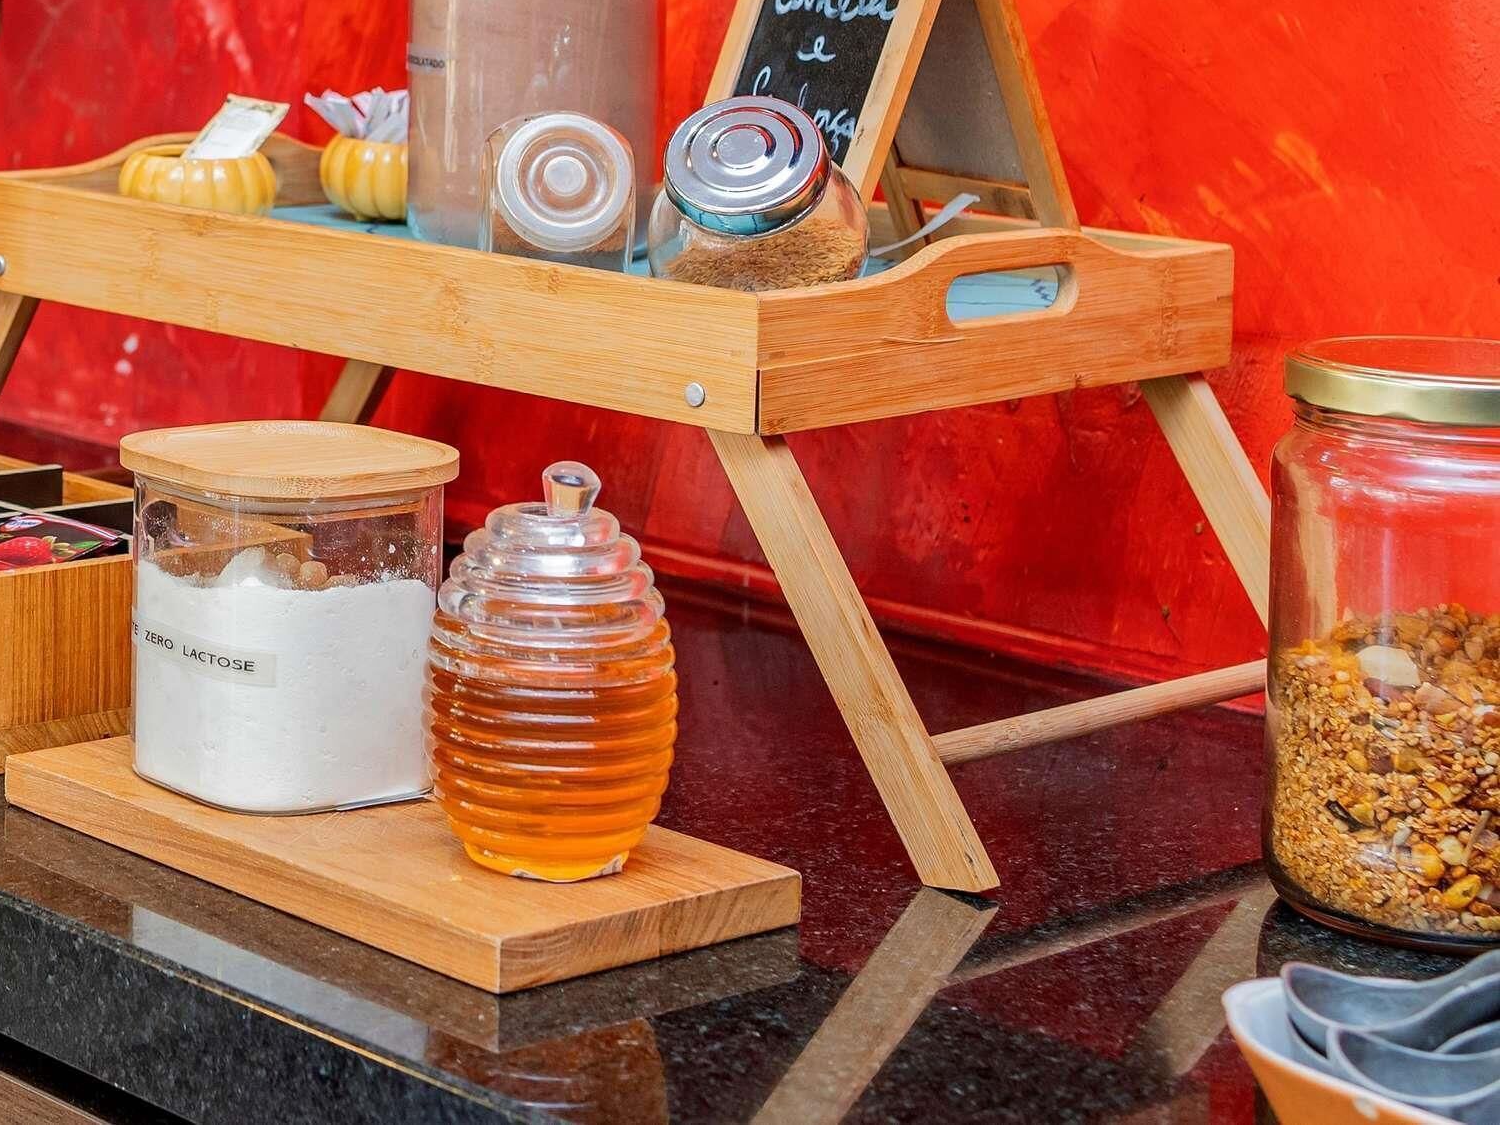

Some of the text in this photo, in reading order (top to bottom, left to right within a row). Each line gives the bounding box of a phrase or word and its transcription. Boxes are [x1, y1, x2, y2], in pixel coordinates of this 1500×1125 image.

[796, 36, 836, 63] e
[145, 629, 174, 650] ZERO
[182, 644, 256, 673] LACTOSE
